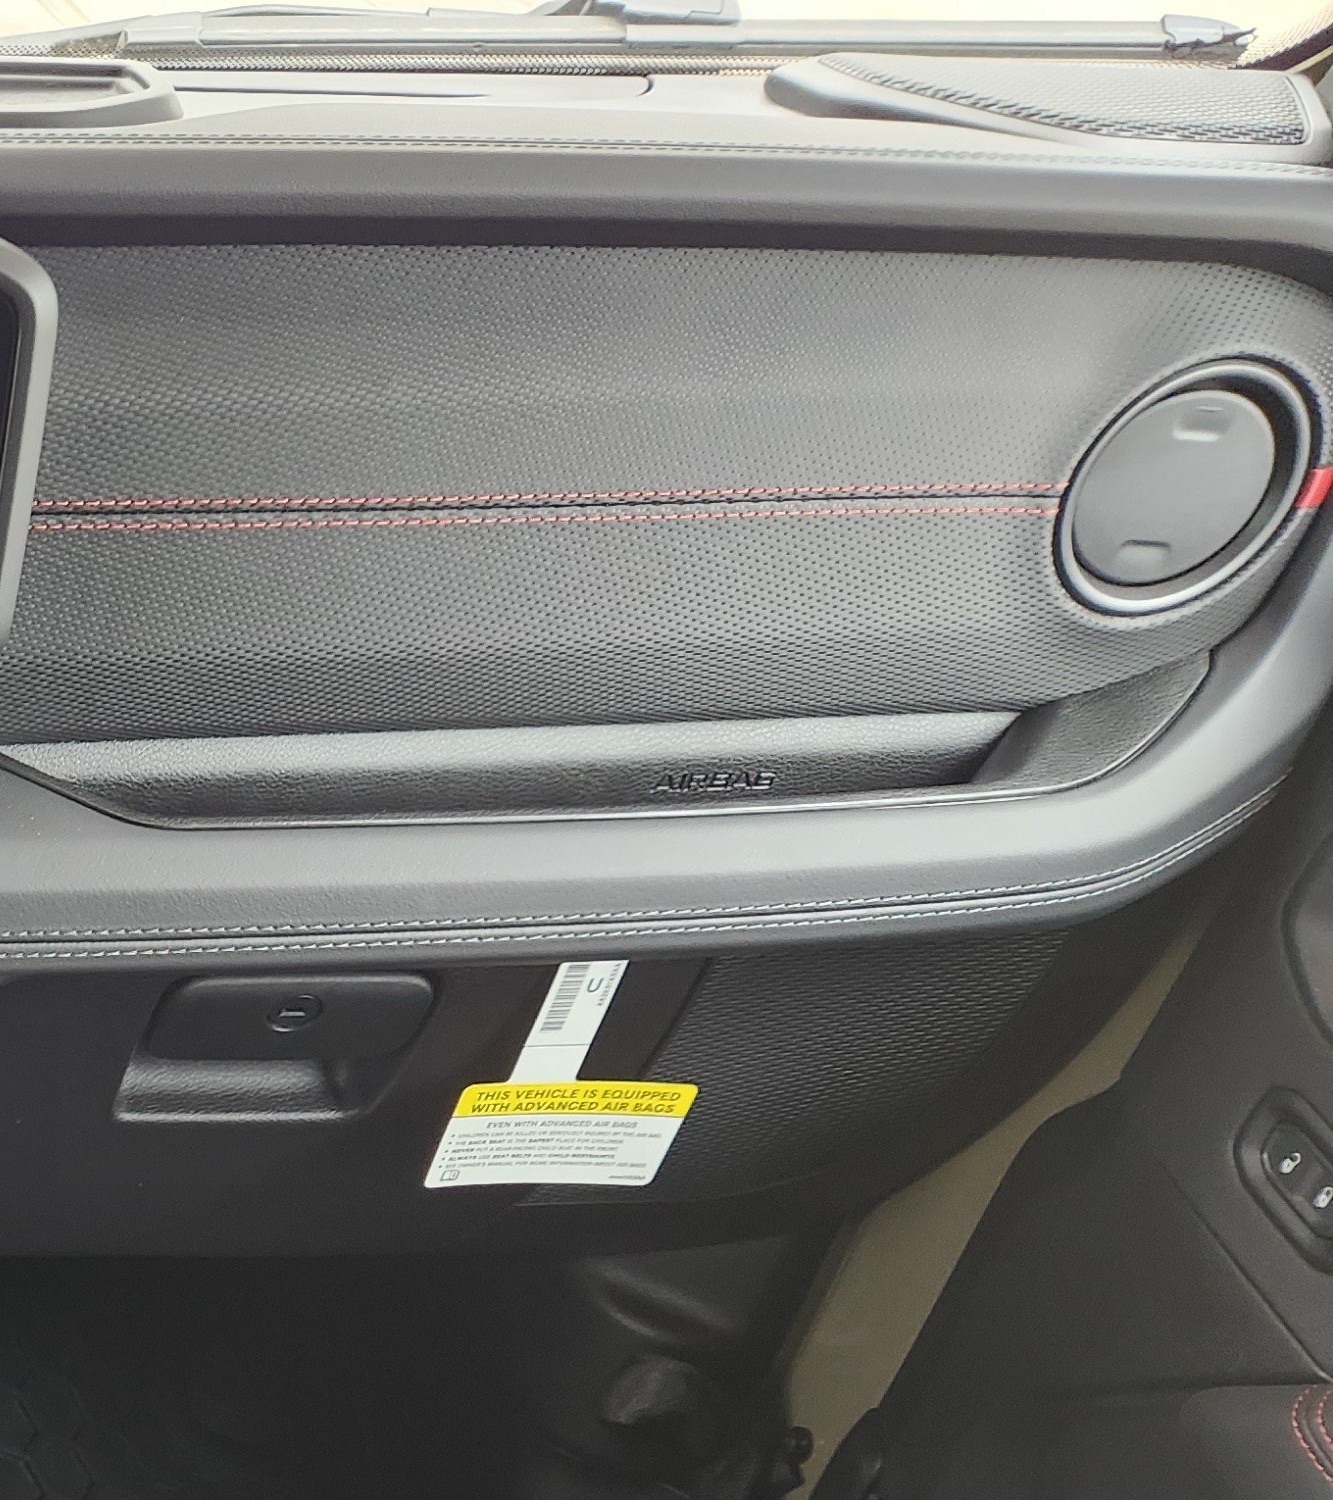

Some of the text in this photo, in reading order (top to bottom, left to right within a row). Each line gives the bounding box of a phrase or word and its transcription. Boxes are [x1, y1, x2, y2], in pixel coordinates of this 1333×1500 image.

[477, 1089, 681, 1101] THIS VEHICLE IS EQUIPPED
[471, 1102, 675, 1114] WITH ADVANCED AIR BAGS
